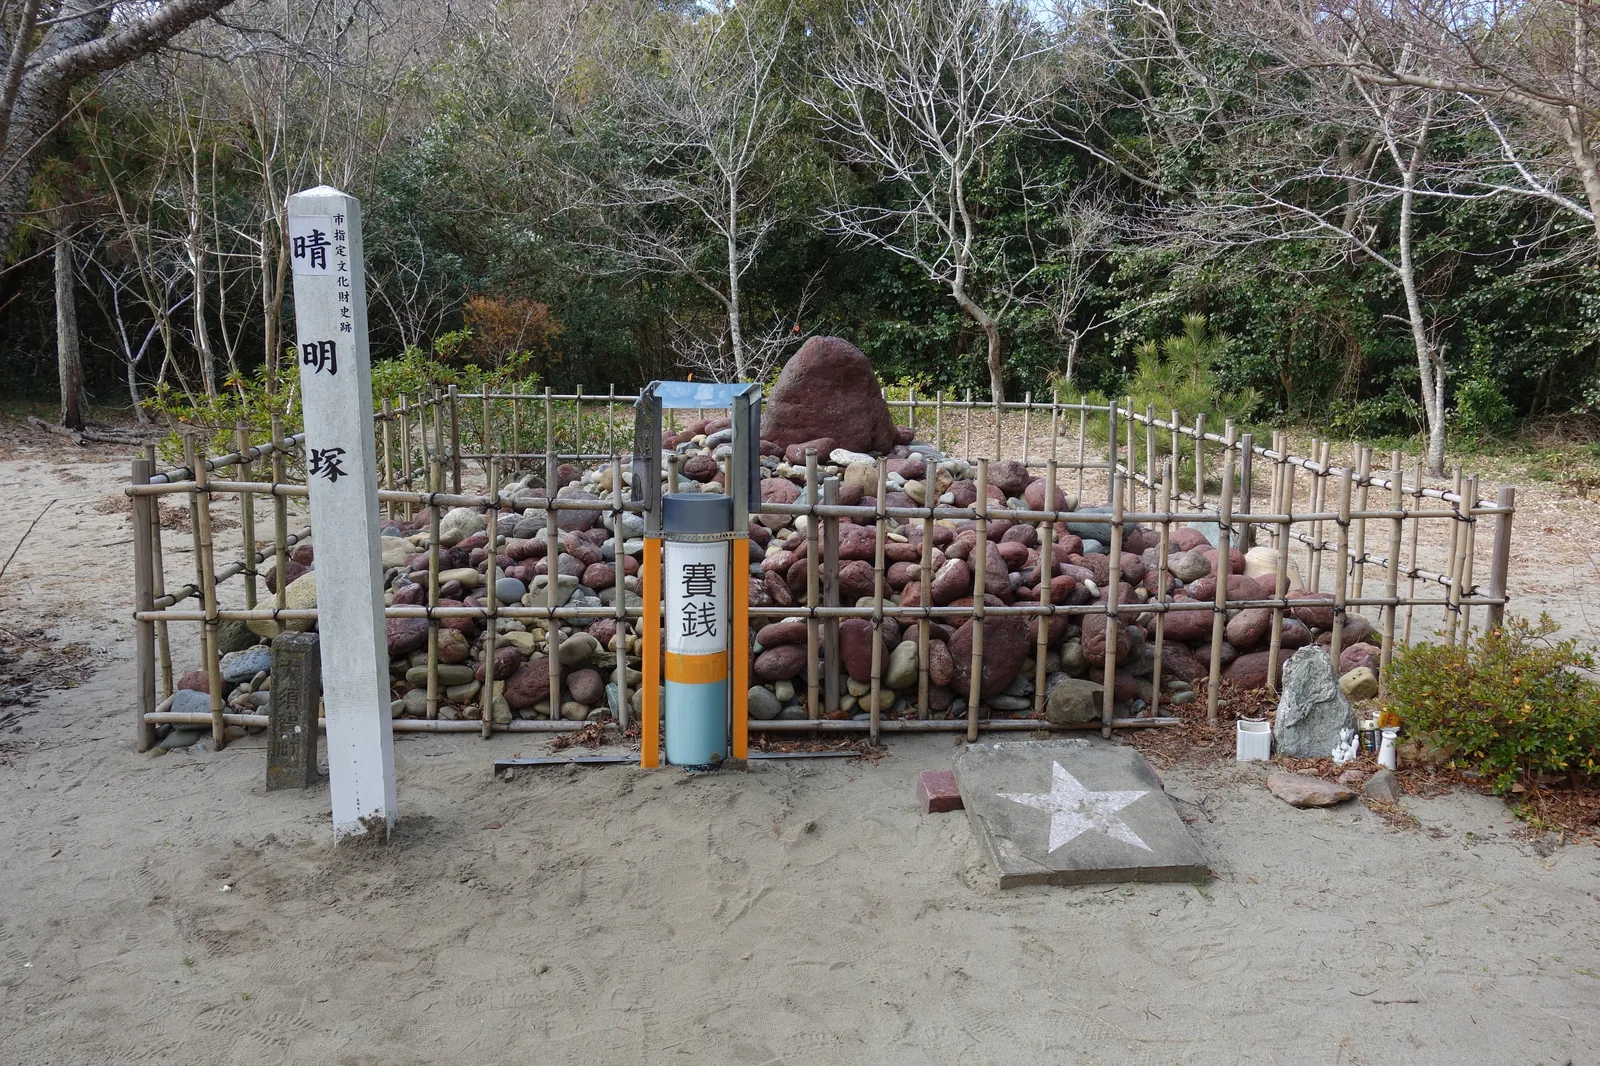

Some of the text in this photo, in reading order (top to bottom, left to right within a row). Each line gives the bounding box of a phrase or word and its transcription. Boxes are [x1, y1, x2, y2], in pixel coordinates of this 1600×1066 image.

[333, 213, 352, 333] 市指定文化財史跡
[292, 229, 348, 483] 晴明塚
[681, 562, 717, 638] 賽銭
